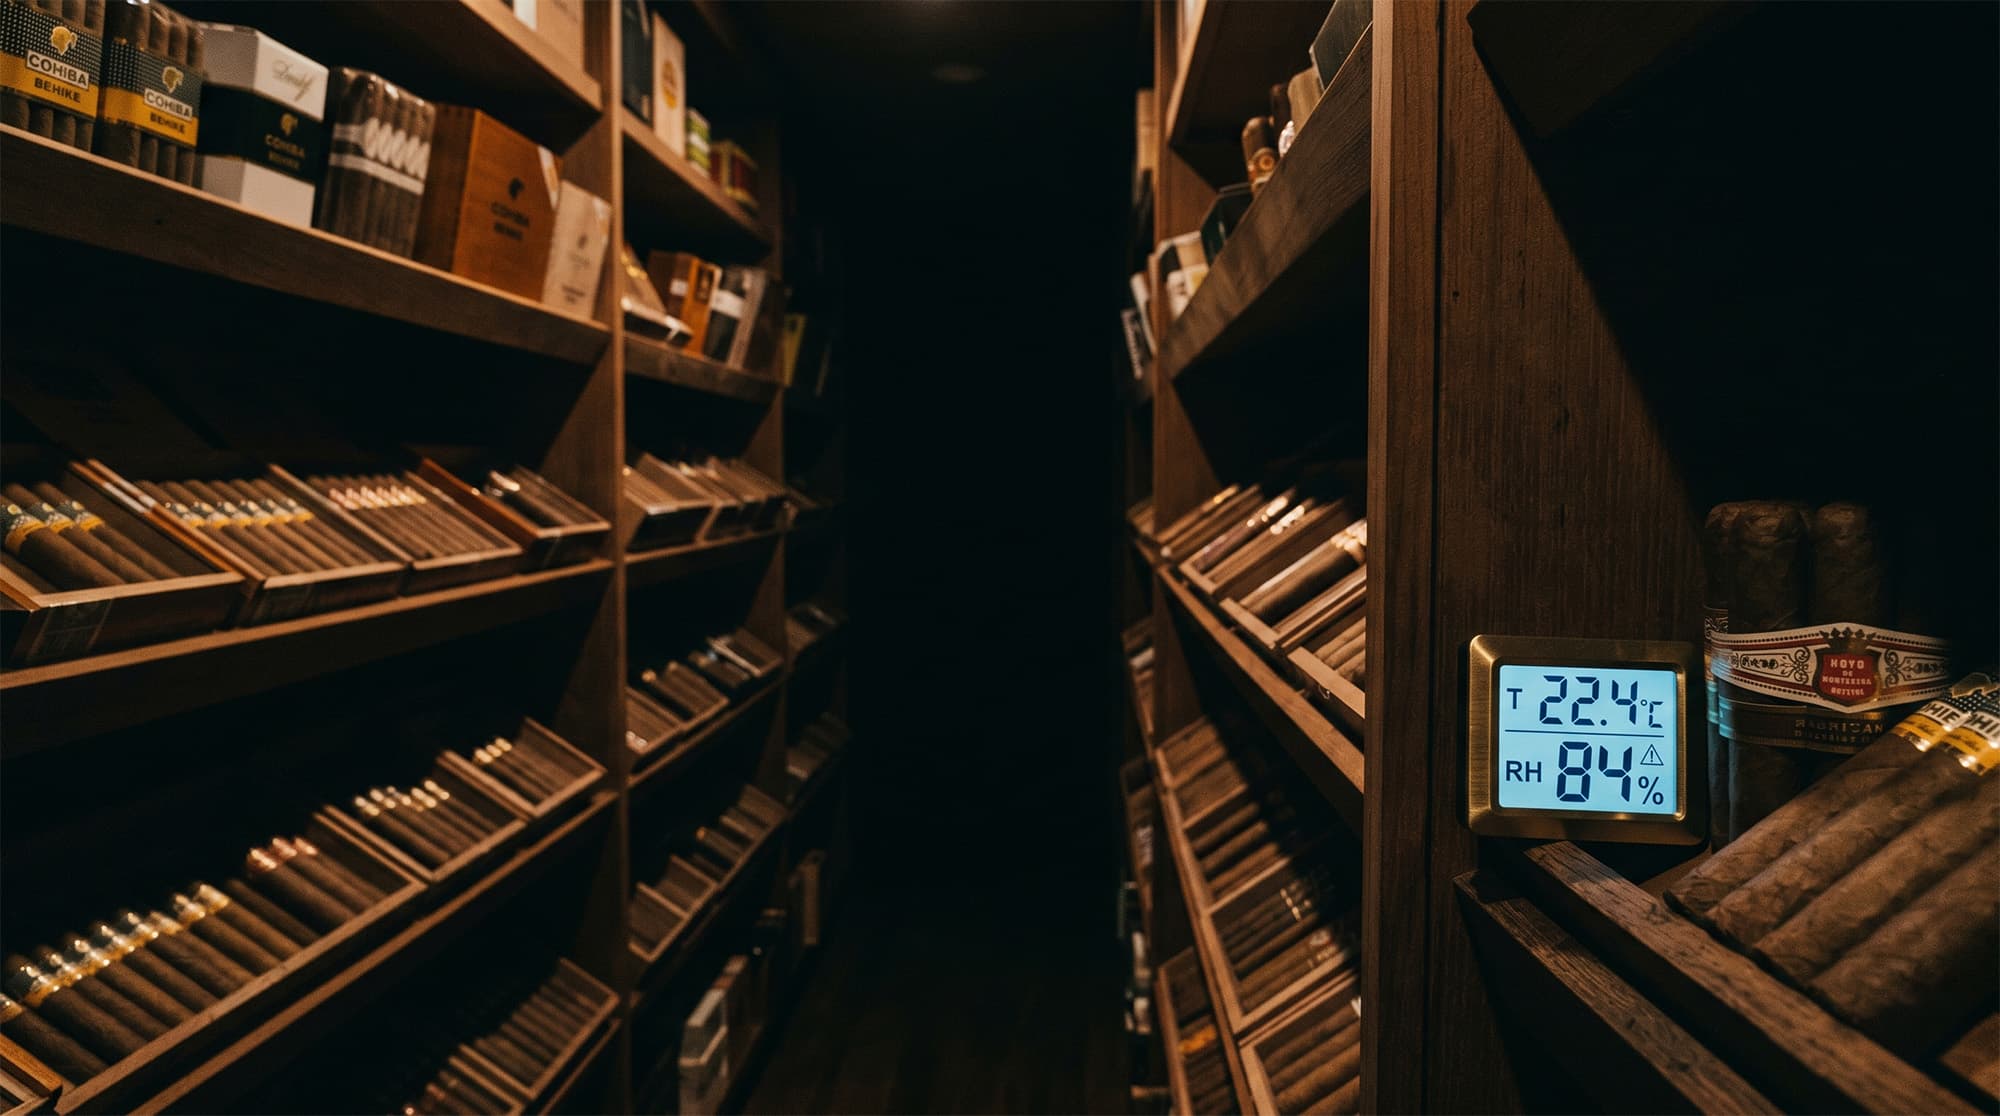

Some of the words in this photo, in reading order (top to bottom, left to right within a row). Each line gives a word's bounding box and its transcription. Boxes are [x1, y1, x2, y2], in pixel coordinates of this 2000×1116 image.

[29, 54, 88, 87] COHIBA
[34, 77, 81, 104] BEHIKE
[146, 91, 191, 118] COHIBA
[1830, 659, 1865, 670] HOYO
[1506, 687, 1523, 709] T
[1506, 760, 1542, 783] RH
